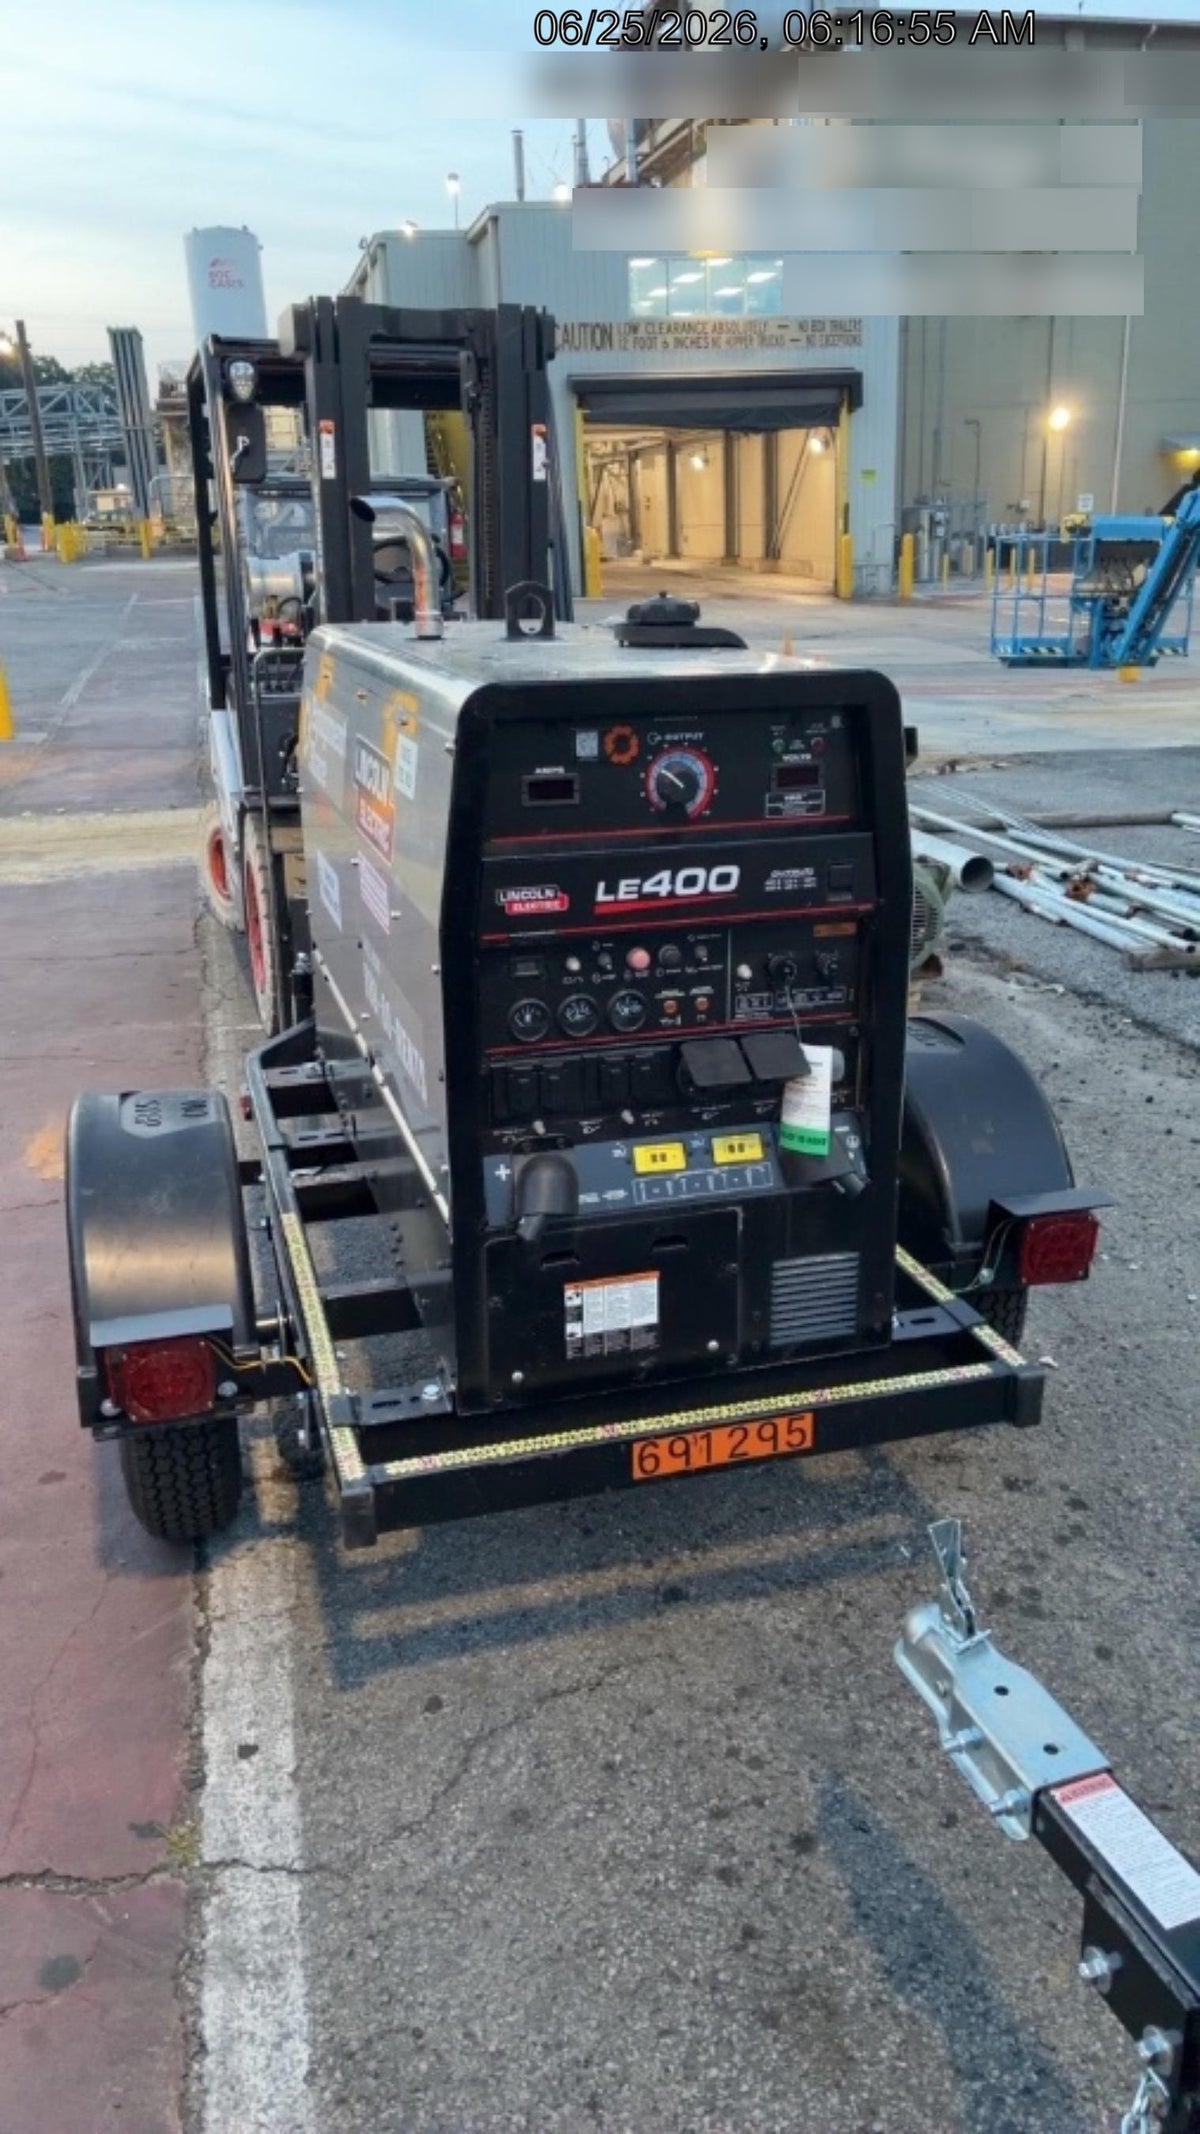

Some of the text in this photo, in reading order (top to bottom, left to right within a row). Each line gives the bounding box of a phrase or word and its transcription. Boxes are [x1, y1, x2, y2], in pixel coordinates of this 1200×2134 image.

[617, 322, 641, 335] LOW
[645, 322, 709, 335] CLEARANCE
[632, 336, 657, 350] FOOT
[673, 336, 710, 349] INCHES
[595, 865, 740, 903] LE400
[500, 888, 555, 902] LINCOLN
[511, 900, 561, 912] ELECTRIC
